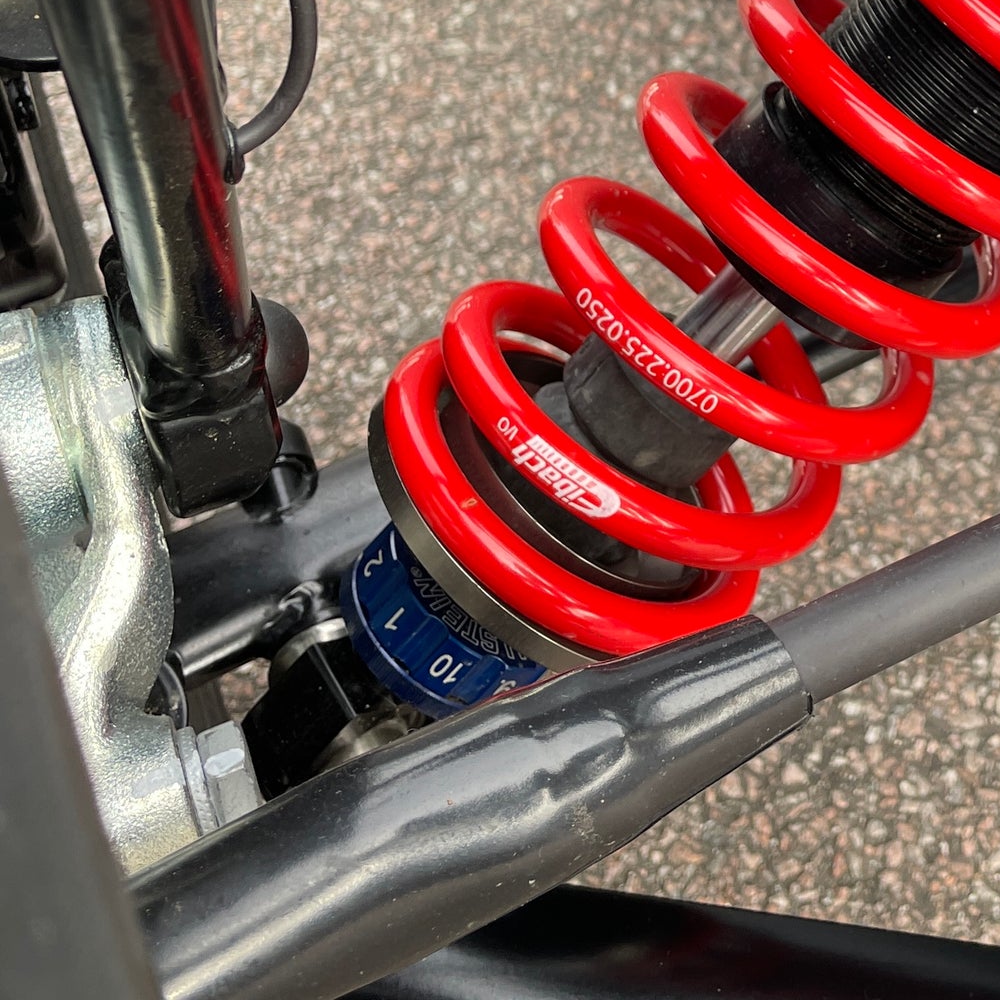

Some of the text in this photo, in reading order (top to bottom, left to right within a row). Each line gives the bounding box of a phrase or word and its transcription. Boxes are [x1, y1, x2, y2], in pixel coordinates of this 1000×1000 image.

[576, 287, 719, 414] 0700.225.0250
[511, 435, 621, 518] Eibach
[364, 549, 383, 577] 2
[384, 607, 405, 631] 1
[429, 654, 465, 684] 10
